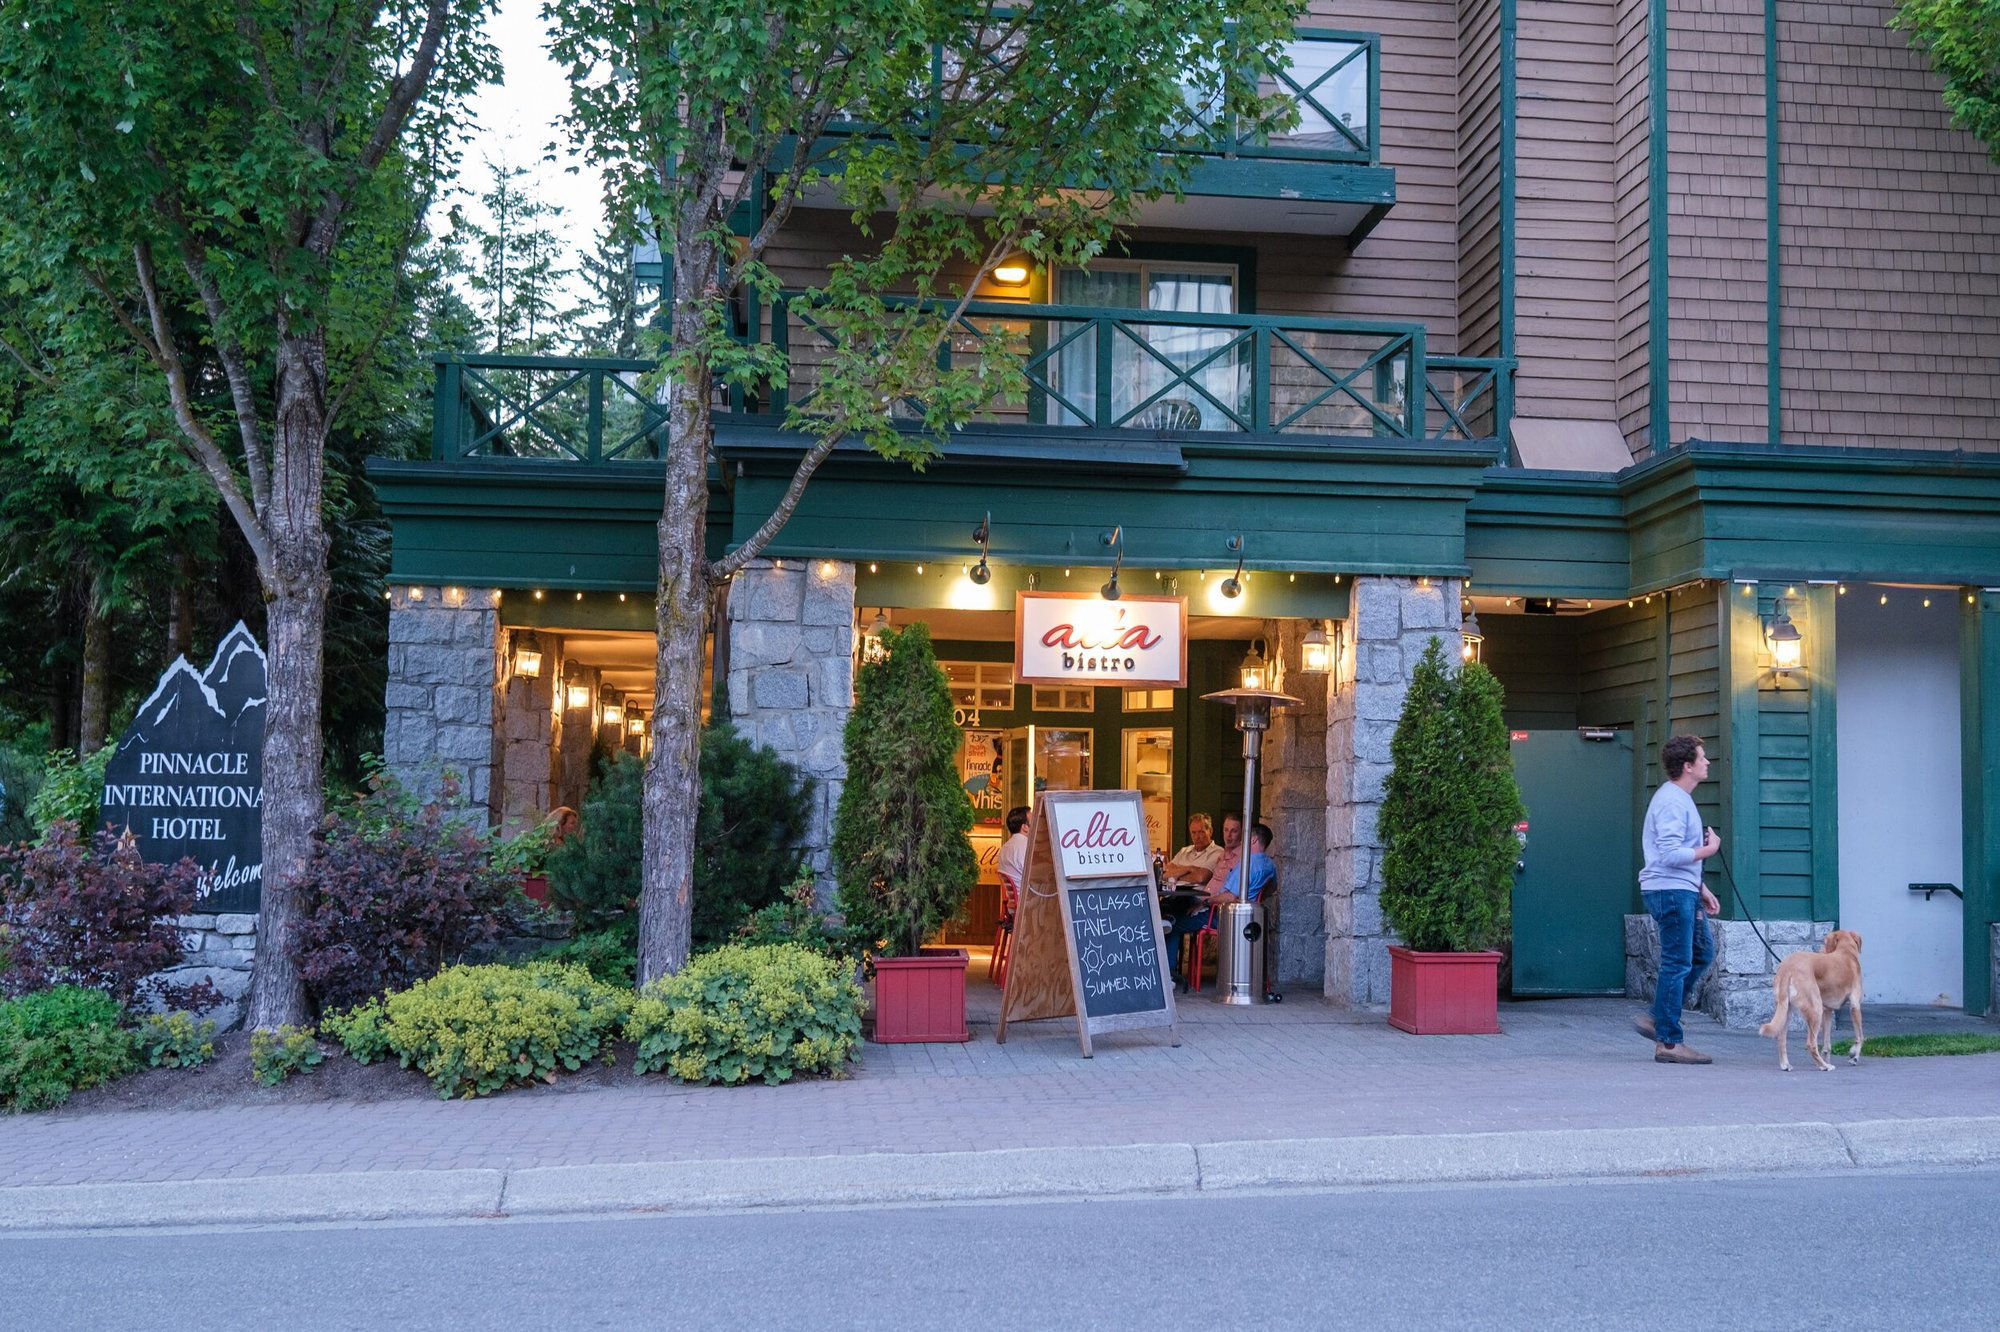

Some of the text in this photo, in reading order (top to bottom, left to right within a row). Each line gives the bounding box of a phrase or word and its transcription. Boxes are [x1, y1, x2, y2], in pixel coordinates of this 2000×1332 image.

[1062, 652, 1135, 670] bistro
[139, 752, 248, 775] PINNACLE
[104, 785, 264, 808] INTERNATIONA
[152, 818, 226, 841] HOTEL
[1061, 811, 1136, 849] alta
[1078, 851, 1124, 865] bistro
[196, 854, 263, 901] Welcom
[1075, 891, 1146, 915] A GLASS OF
[1072, 916, 1151, 943] TAVEL ROSÉ
[1107, 946, 1156, 967] ON A HOT
[1085, 968, 1157, 997] SUMMER DAY!
